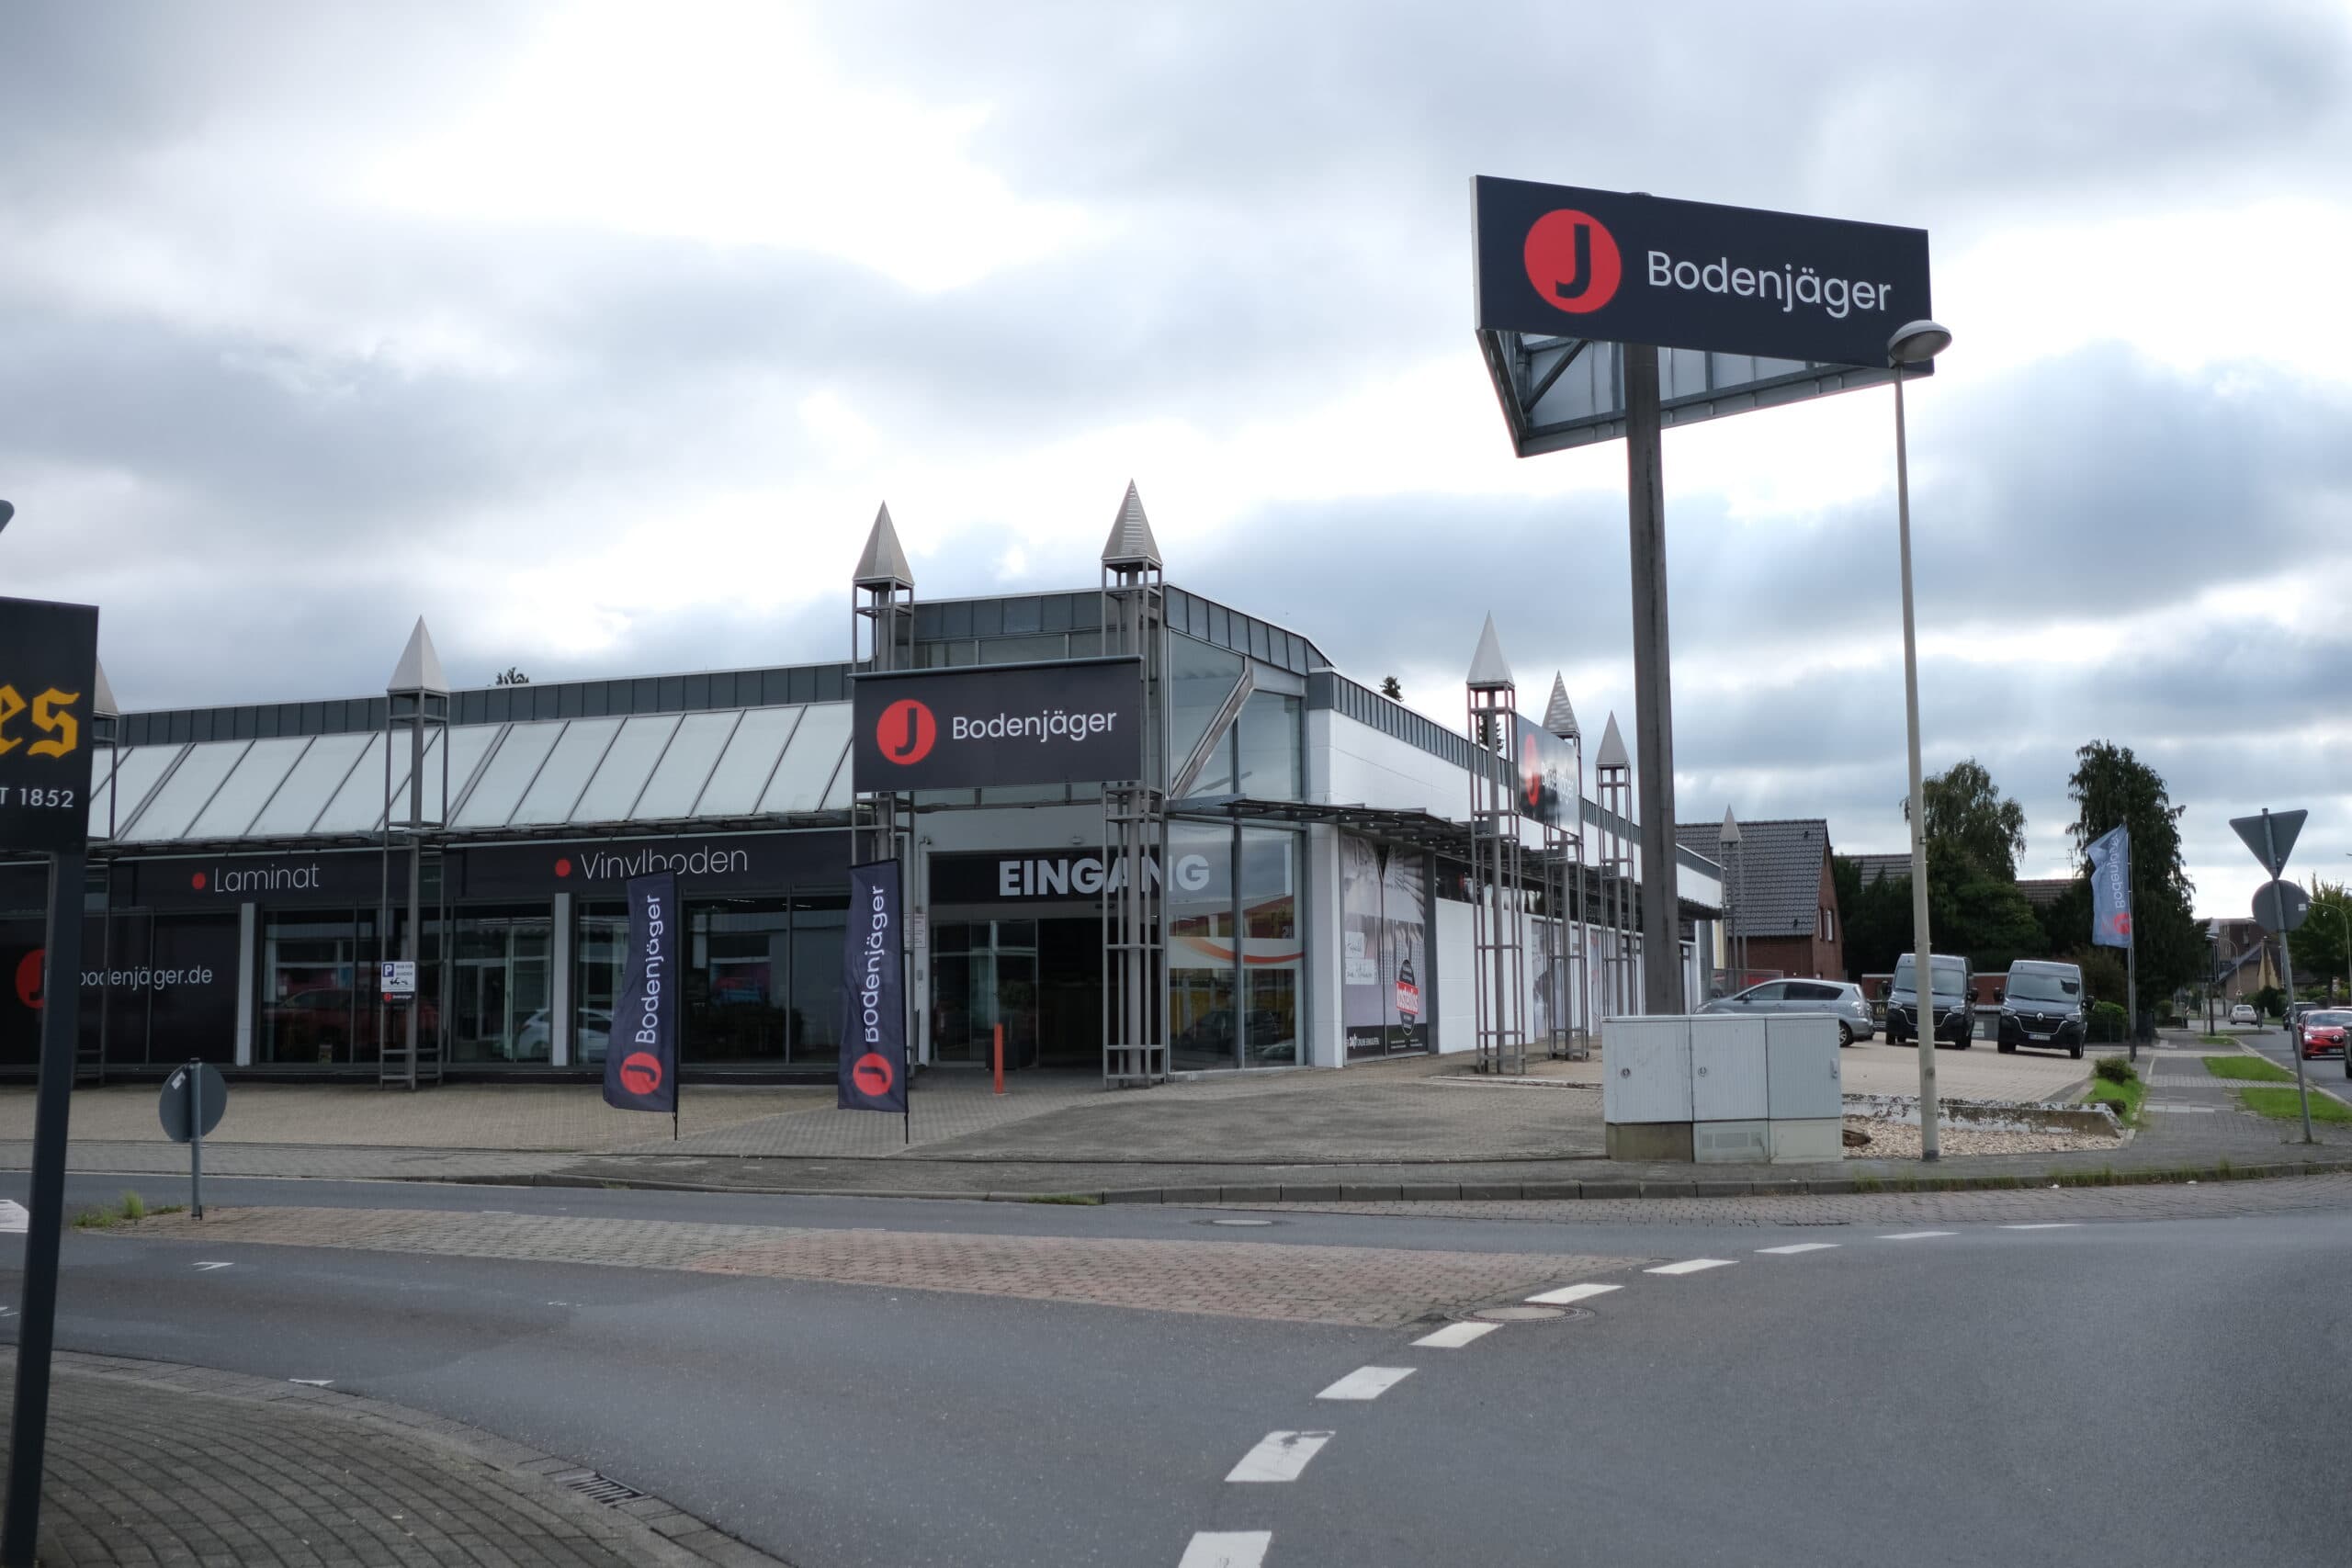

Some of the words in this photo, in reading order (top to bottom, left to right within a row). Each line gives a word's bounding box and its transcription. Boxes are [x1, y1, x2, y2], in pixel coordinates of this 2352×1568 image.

[1555, 222, 1592, 299] J
[1646, 250, 1892, 319] Bodenjäger
[894, 707, 919, 756] J
[952, 710, 1117, 742] Bodenjäger
[20, 788, 74, 807] 1852
[214, 863, 321, 892] Laminat
[635, 895, 664, 1044] Bodenjäger
[861, 886, 888, 1043] Bodenjäger
